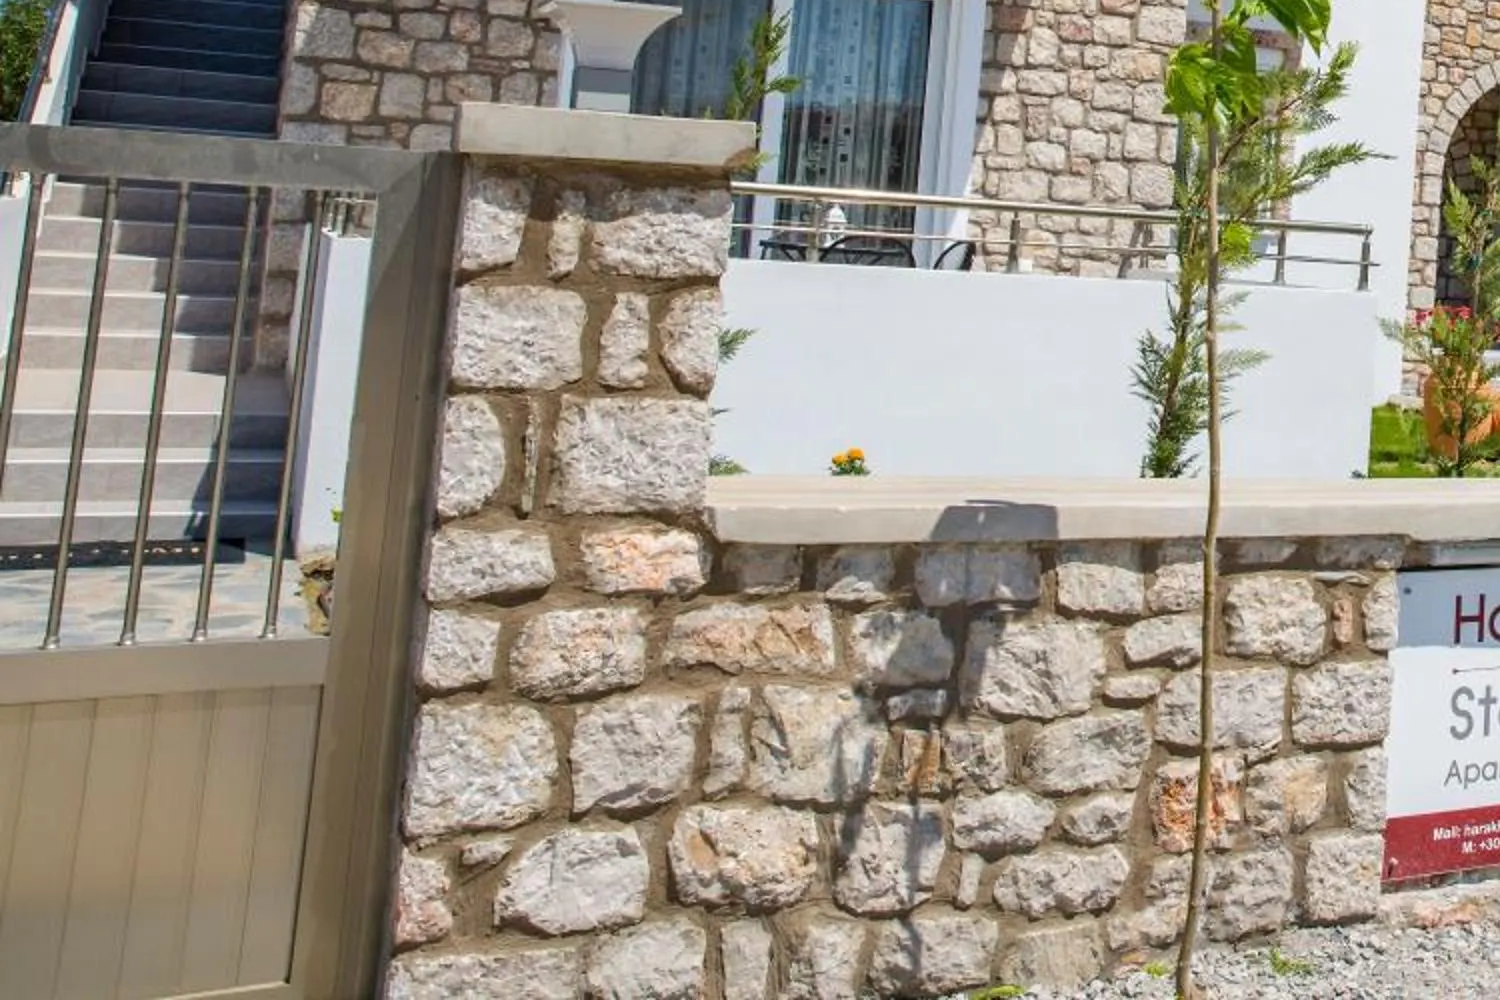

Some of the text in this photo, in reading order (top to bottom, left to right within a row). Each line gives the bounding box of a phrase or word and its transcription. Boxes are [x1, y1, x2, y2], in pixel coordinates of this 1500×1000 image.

[1433, 825, 1461, 840] Mail:
[1461, 840, 1477, 853] M:
[1479, 837, 1500, 850] +30
